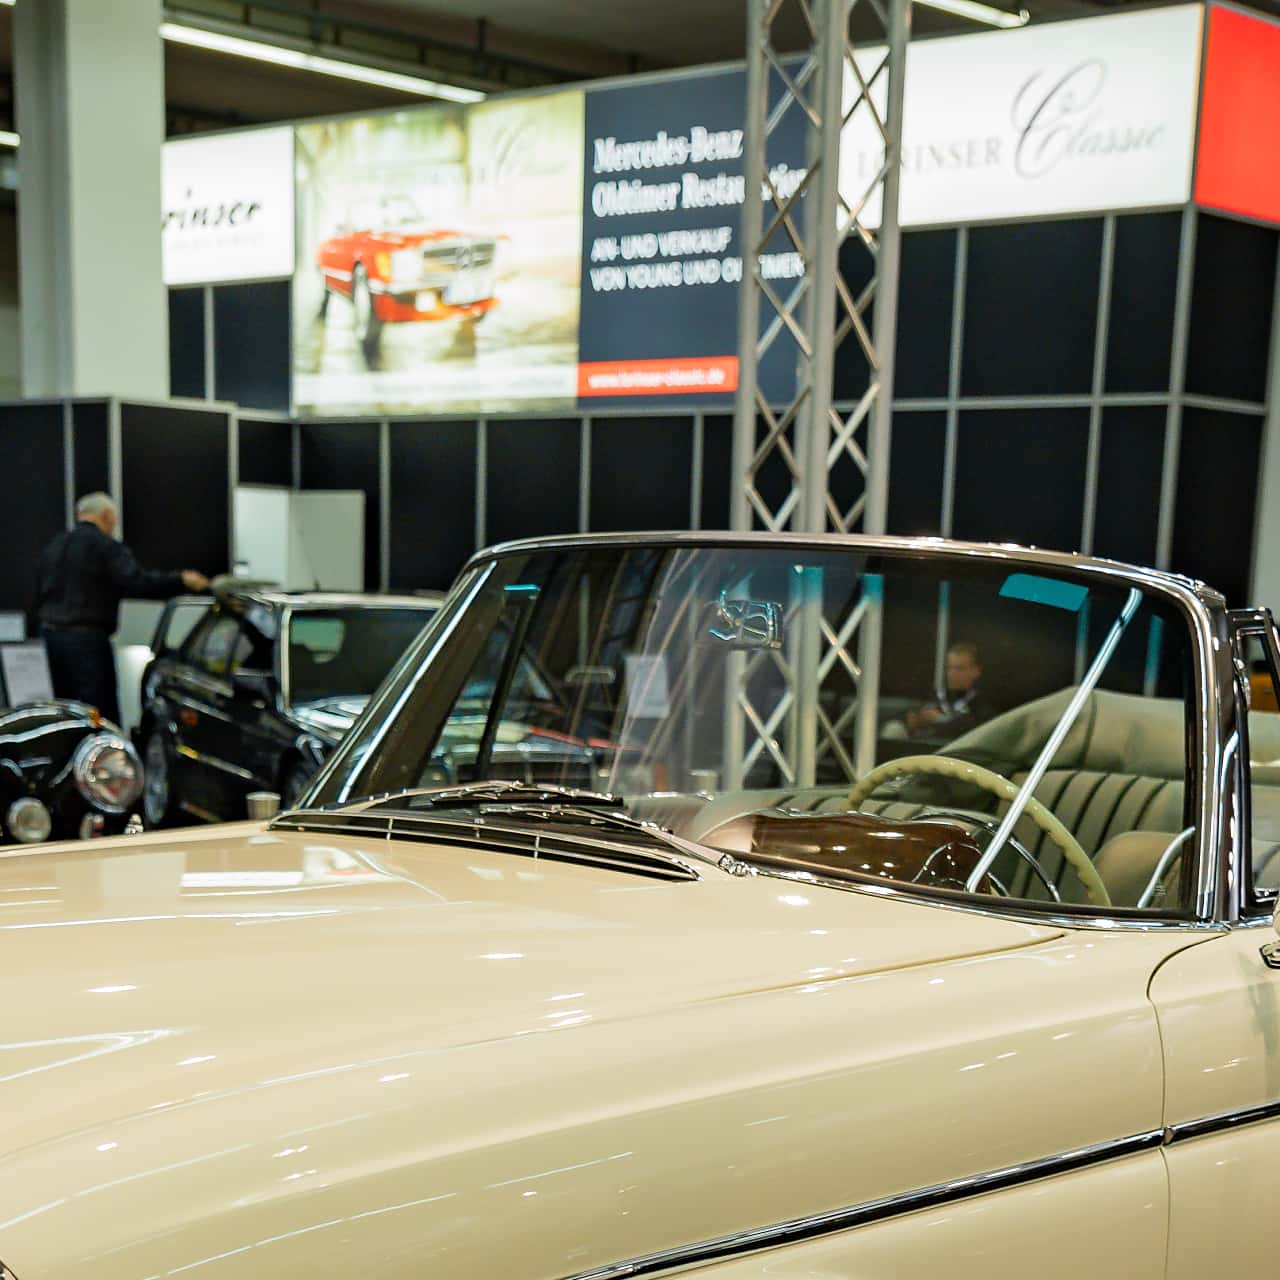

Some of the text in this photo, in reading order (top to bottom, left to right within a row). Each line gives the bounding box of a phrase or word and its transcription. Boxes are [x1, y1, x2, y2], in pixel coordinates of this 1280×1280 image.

[1010, 57, 1168, 180] Classic
[593, 126, 744, 174] Mercedes-Benz
[592, 179, 682, 217] Oldtimer
[620, 233, 658, 259] UND
[658, 226, 732, 256] VERKAUF
[590, 266, 626, 291] VON
[627, 261, 682, 289] YOUNG
[683, 258, 721, 285] UND
